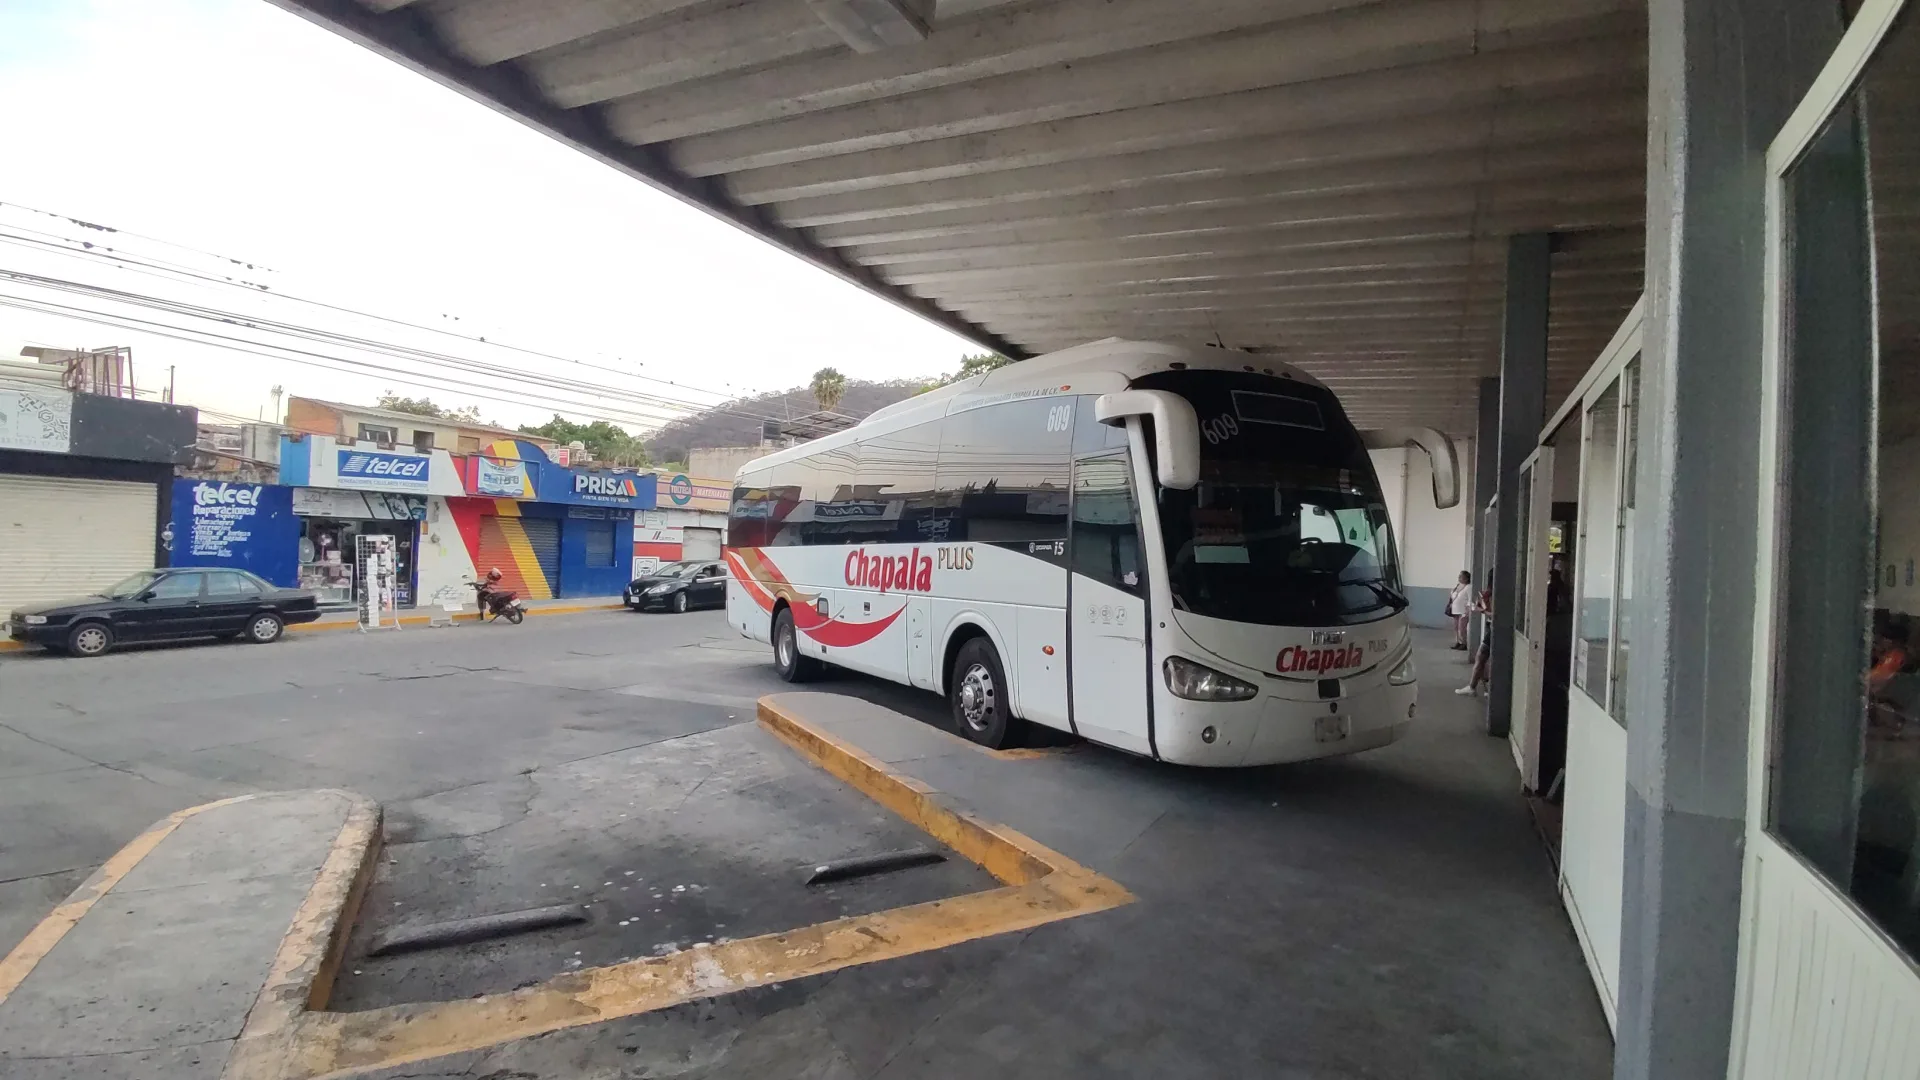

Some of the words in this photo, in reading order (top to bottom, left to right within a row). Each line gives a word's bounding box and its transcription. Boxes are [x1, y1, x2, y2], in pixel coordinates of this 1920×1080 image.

[1047, 404, 1071, 432] 609
[1201, 413, 1239, 445] 609
[365, 457, 425, 477] telcel
[192, 482, 263, 506] telcel
[575, 474, 629, 497] PRISA
[696, 488, 730, 498] MATERIALES
[193, 504, 257, 517] Reparaciones
[1054, 541, 1065, 556] i5
[844, 546, 933, 593] Chapala
[937, 546, 974, 571] PLUS
[1275, 641, 1363, 676] Chapala
